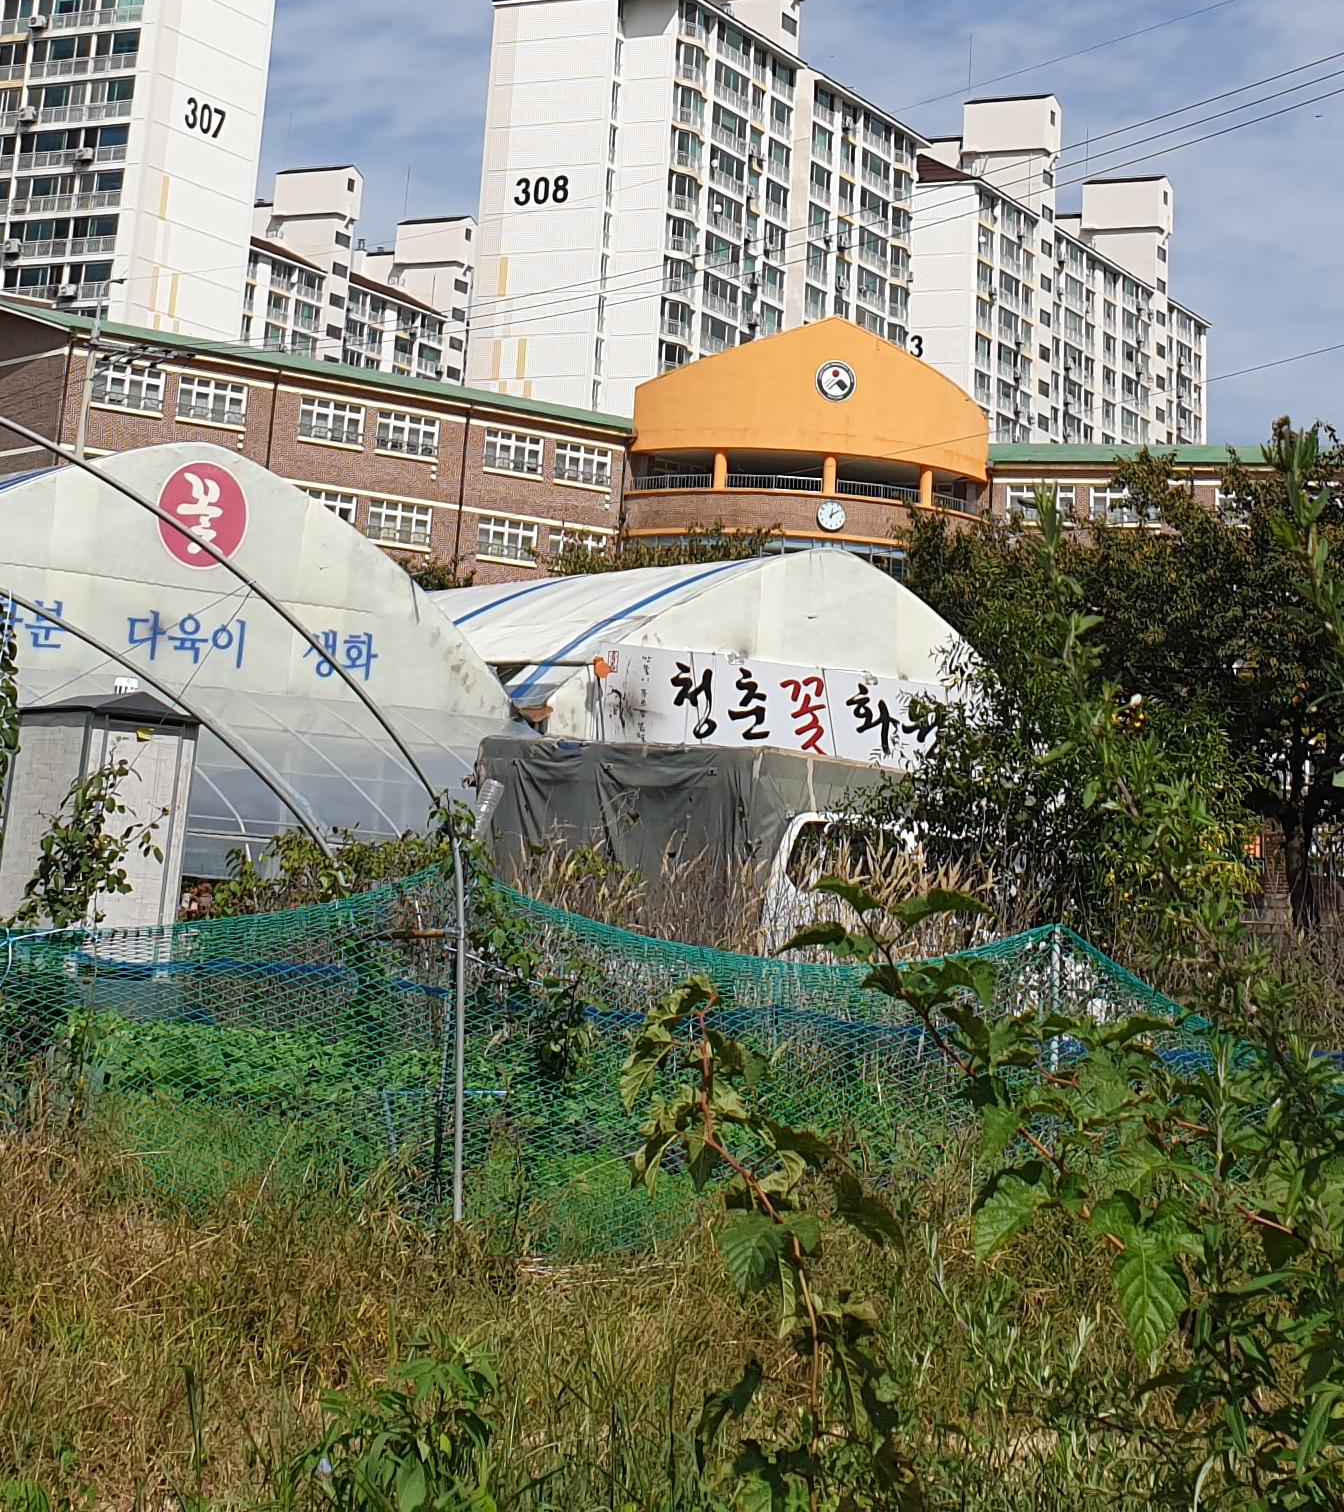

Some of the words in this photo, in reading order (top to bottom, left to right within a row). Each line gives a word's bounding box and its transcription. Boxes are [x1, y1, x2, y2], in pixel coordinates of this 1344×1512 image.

[184, 97, 226, 138] 307
[514, 175, 569, 206] 308
[176, 472, 224, 554] 꽃
[127, 609, 246, 669] 다육이
[302, 629, 379, 681] 생화
